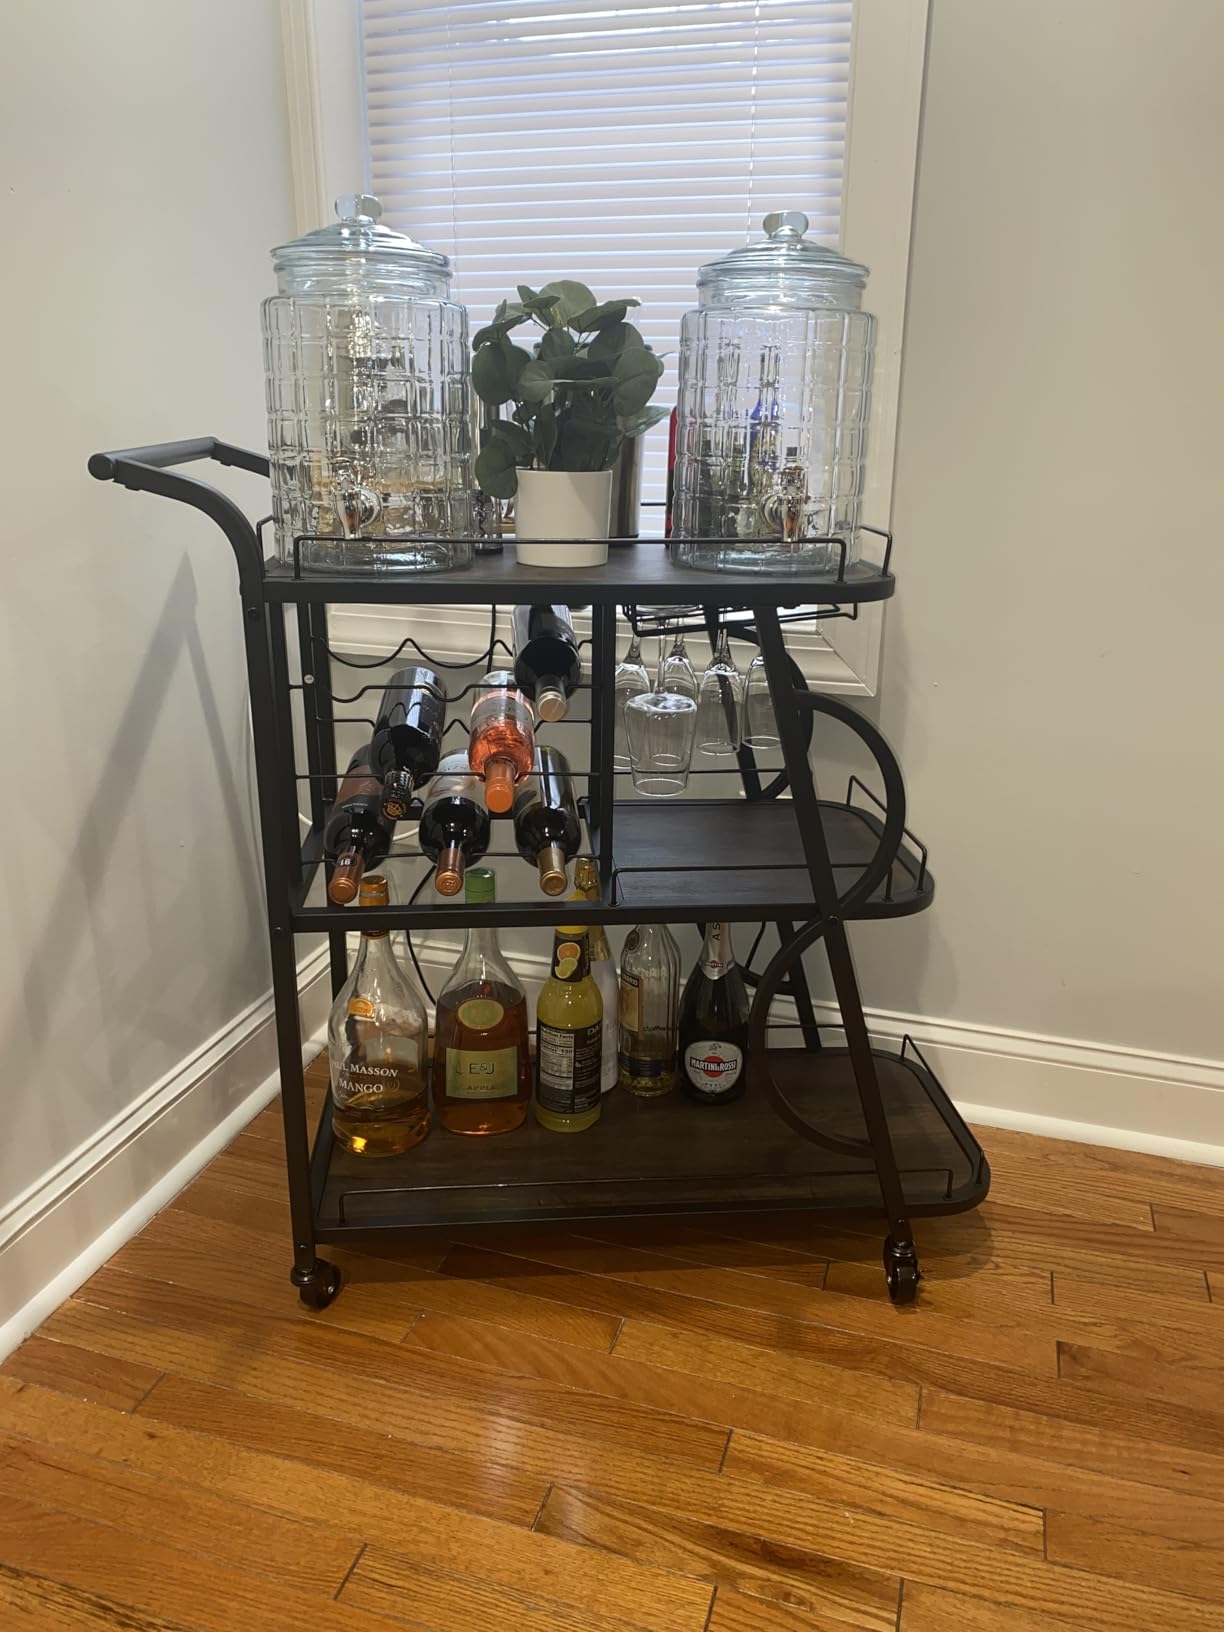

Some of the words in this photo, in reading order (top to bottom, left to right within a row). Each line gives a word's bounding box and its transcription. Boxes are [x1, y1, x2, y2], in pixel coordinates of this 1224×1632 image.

[350, 1063, 399, 1078] MASSON
[469, 1062, 495, 1075] E&J
[338, 1078, 384, 1094] MANGO
